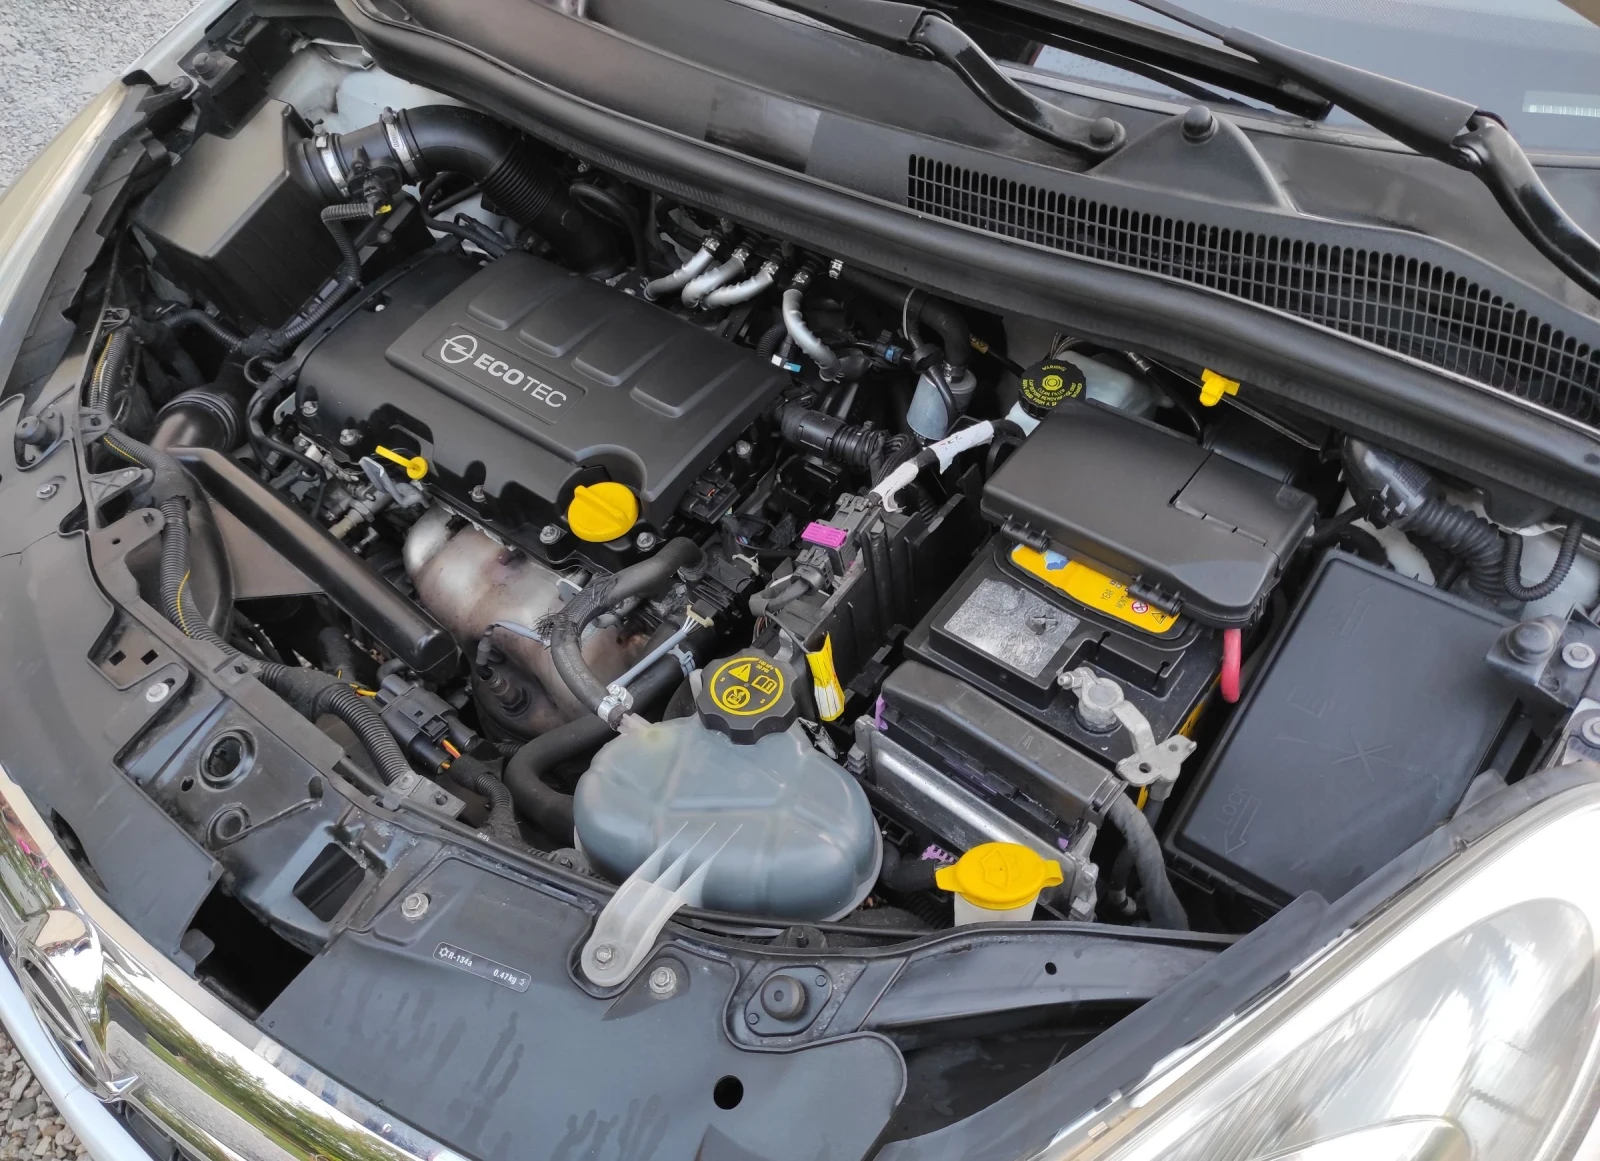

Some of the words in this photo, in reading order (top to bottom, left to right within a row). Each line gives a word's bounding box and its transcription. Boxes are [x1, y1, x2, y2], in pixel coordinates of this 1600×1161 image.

[473, 353, 567, 407] ECOTEC
[1215, 783, 1251, 826] LOCK
[448, 951, 473, 967] R-134a
[493, 969, 517, 985] 0.47kg
